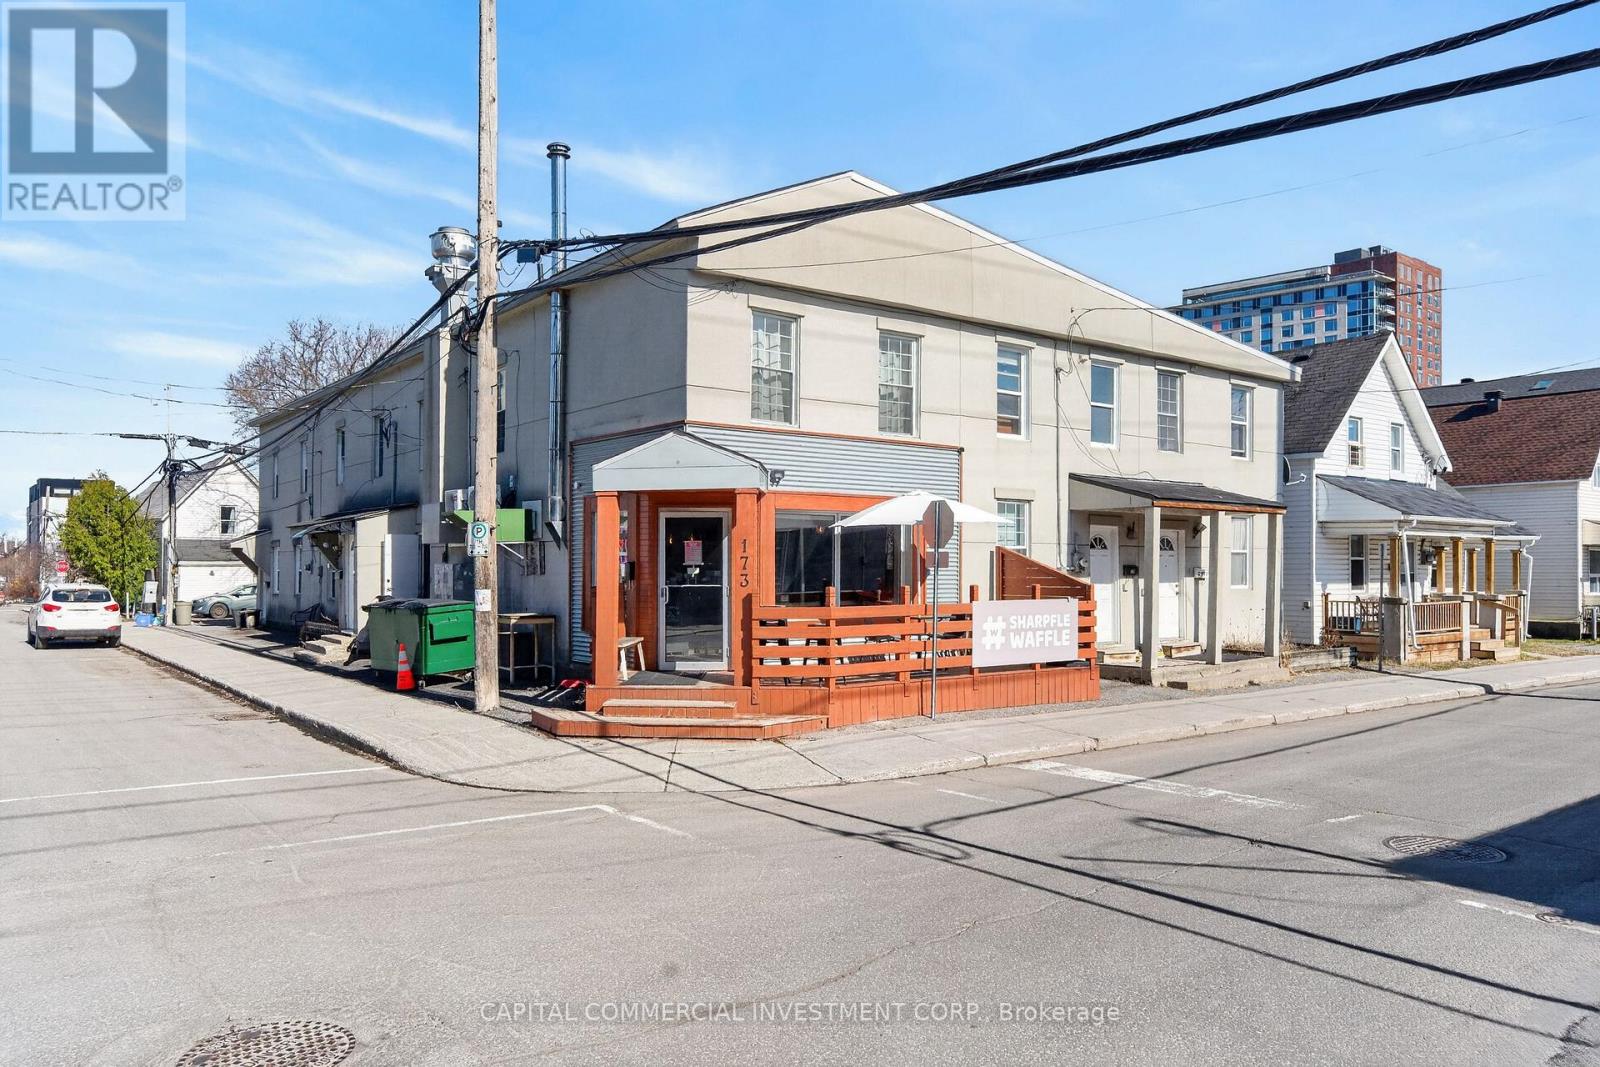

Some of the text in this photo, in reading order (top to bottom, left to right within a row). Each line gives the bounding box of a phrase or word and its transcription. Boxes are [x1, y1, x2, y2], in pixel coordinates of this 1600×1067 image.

[739, 538, 749, 588] 173
[1009, 613, 1071, 630] SHARPFLE
[1009, 629, 1071, 649] WAFFLE
